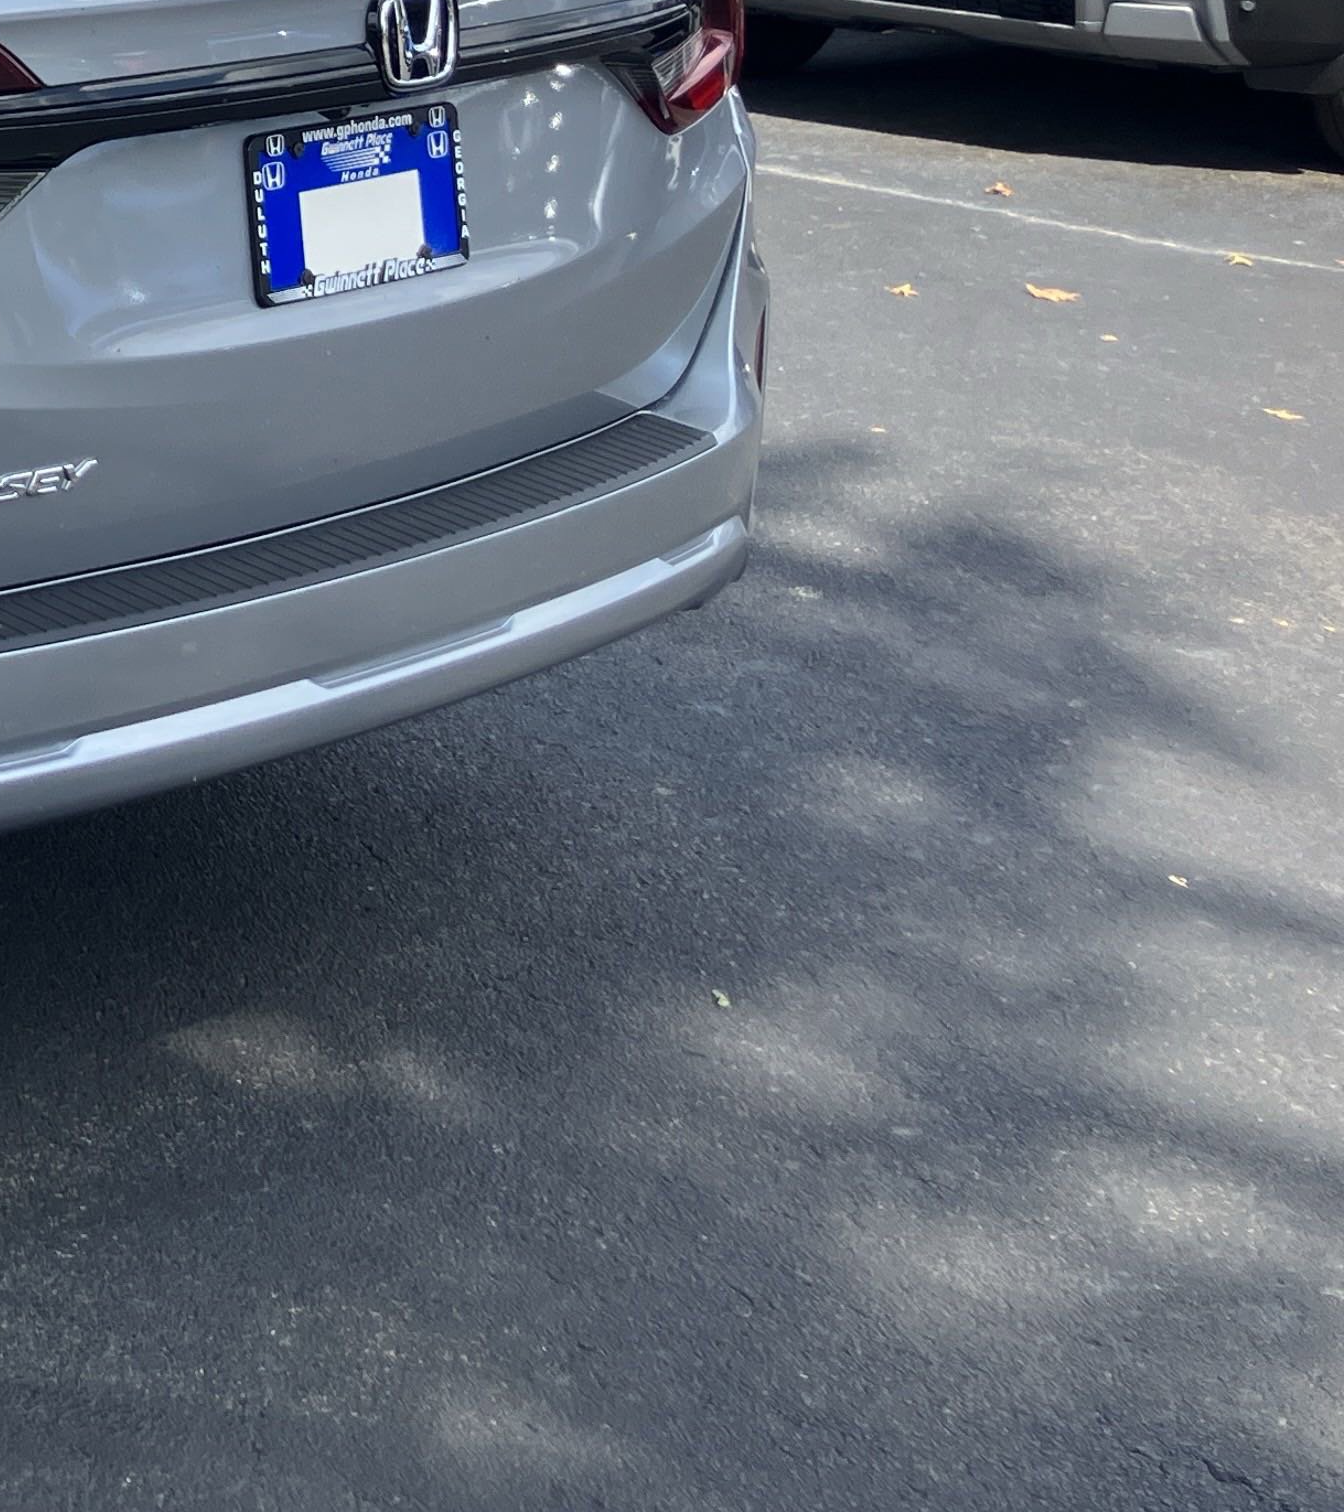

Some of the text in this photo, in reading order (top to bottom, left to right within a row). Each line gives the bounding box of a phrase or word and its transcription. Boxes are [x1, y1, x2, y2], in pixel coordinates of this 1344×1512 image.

[302, 113, 412, 142] www.gphonda.com
[341, 168, 379, 182] Honda
[453, 130, 470, 238] GEORGIA
[253, 172, 271, 274] DULUTH
[314, 258, 424, 296] Gwinnett Place
